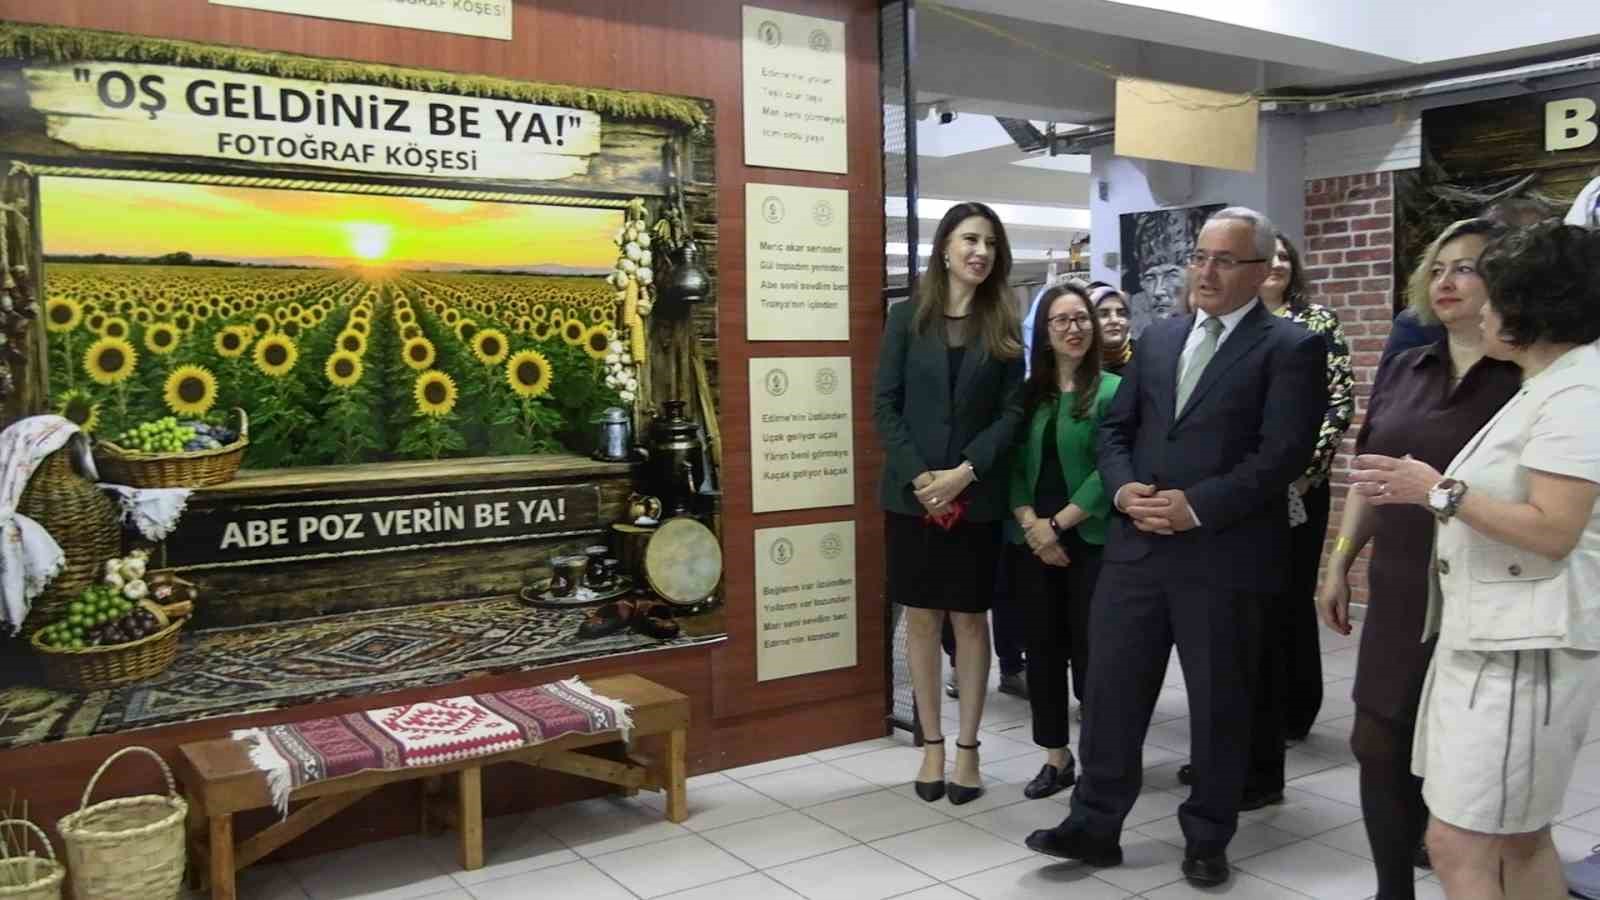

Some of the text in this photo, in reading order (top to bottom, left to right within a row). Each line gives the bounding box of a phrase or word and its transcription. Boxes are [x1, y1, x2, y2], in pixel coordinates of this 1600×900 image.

[73, 67, 167, 120] "OŞ
[428, 102, 481, 139] BE
[495, 109, 582, 146] YA!"
[217, 132, 375, 164] FOTOĞRAF
[219, 498, 566, 549] ABE POZ VERİN BE YA!
